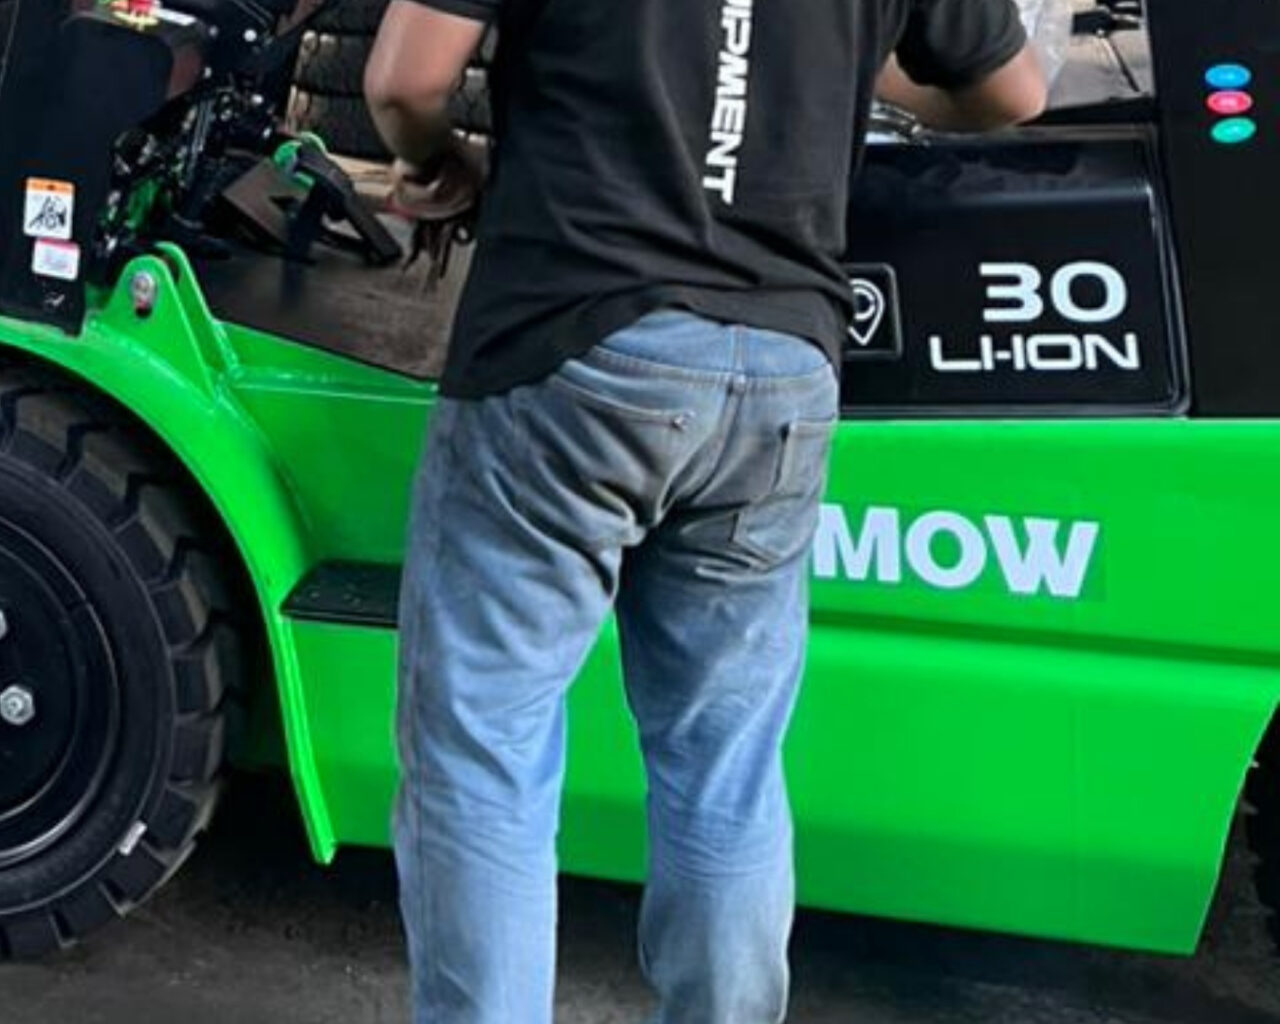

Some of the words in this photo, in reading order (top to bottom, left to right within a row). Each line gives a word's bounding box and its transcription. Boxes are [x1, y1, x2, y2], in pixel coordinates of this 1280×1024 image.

[979, 261, 1127, 322] 30
[929, 332, 1140, 371] LI-ION
[813, 502, 1099, 597] MOW
